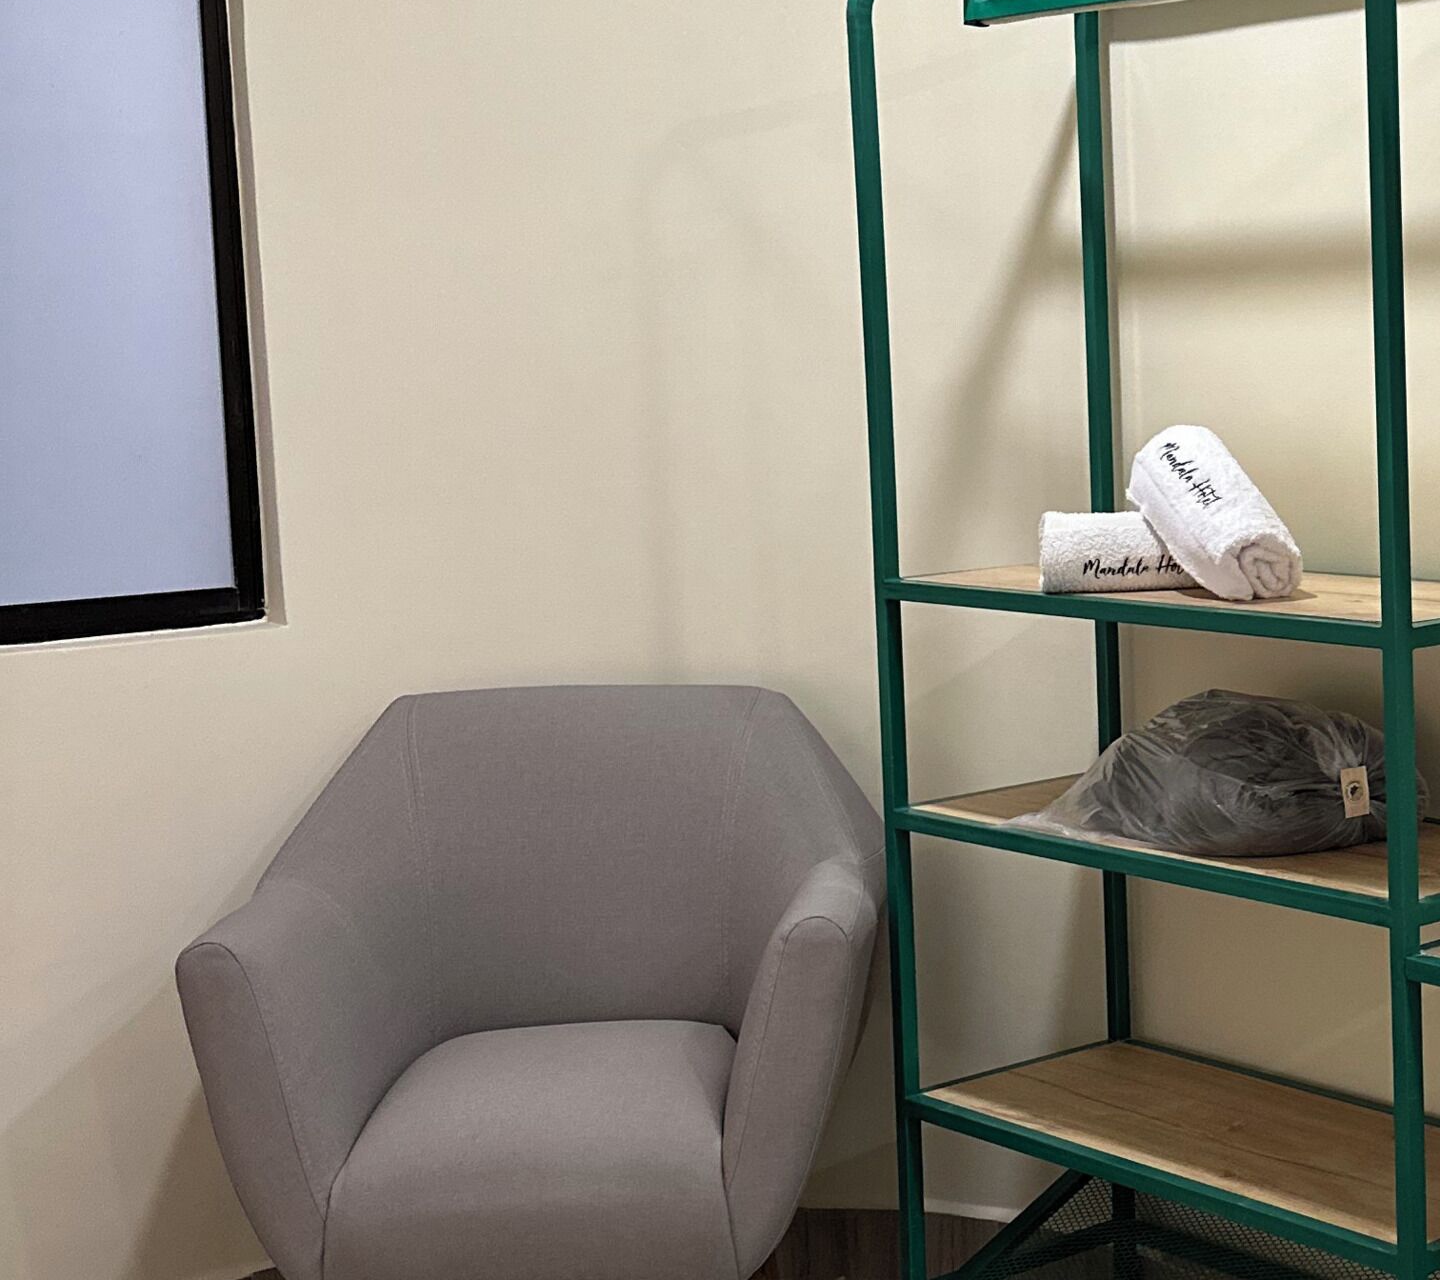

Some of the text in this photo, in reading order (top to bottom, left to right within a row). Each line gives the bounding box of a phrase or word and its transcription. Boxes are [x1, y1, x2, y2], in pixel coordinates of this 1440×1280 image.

[1159, 442, 1222, 510] Mandala Hotel
[1083, 557, 1149, 579] Mandala
